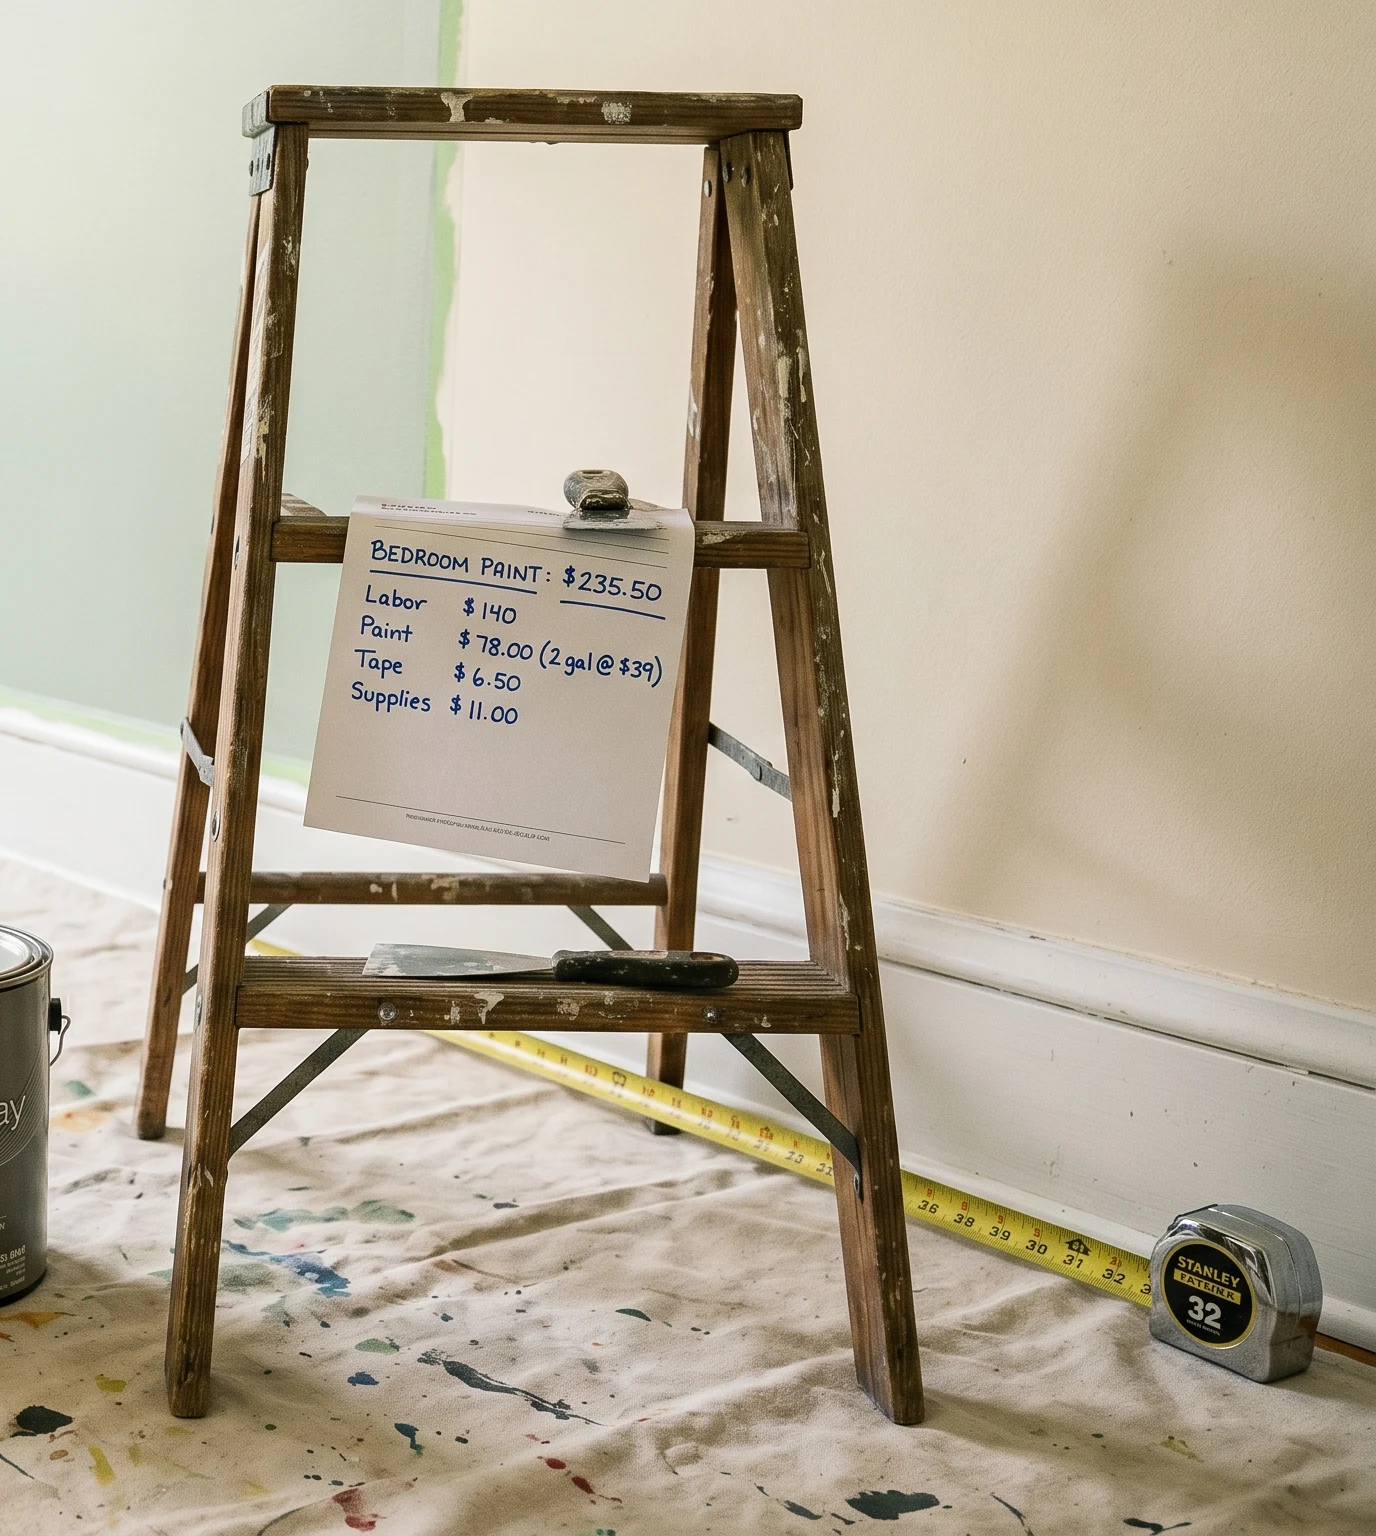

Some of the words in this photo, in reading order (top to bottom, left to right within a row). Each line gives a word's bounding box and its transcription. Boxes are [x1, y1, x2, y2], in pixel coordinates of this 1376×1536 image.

[370, 539, 469, 574] BEDROOM
[481, 557, 550, 583] PAINT:
[562, 565, 662, 602] $235.50
[364, 584, 427, 611] Labor
[360, 615, 413, 643] Paint
[354, 648, 403, 675] Tape
[351, 681, 431, 713] Supplies
[917, 1200, 939, 1214] 36
[953, 1213, 975, 1228] 38
[989, 1226, 1011, 1241] 39
[1025, 1239, 1048, 1255] 30
[1062, 1254, 1084, 1269] 31
[1102, 1268, 1126, 1285] 32
[1177, 1255, 1240, 1288] STANLEY
[1188, 1295, 1222, 1329] 32
